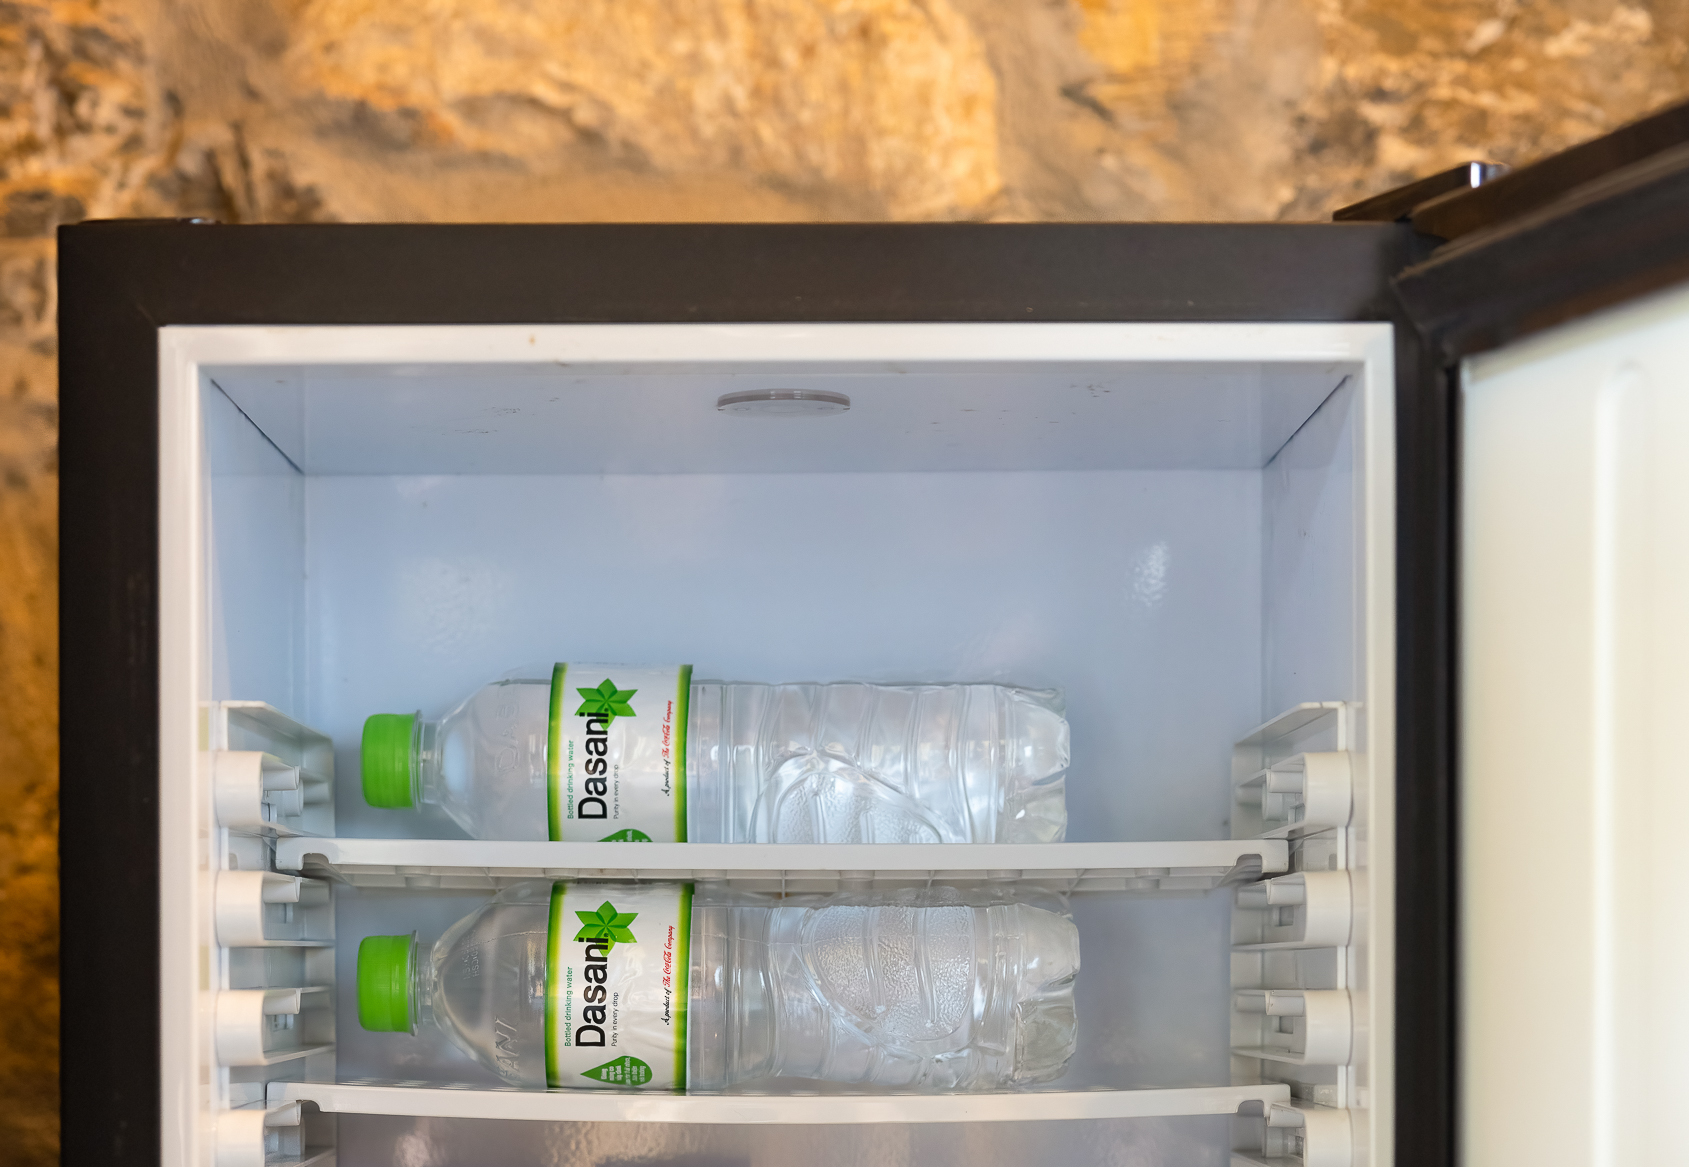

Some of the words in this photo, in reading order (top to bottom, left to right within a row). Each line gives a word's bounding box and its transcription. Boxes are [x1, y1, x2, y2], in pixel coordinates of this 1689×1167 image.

[577, 712, 609, 819] Dasani
[664, 925, 674, 950] Company
[575, 937, 608, 1047] Dasani
[663, 976, 671, 987] The
[565, 990, 573, 1020] drinking
